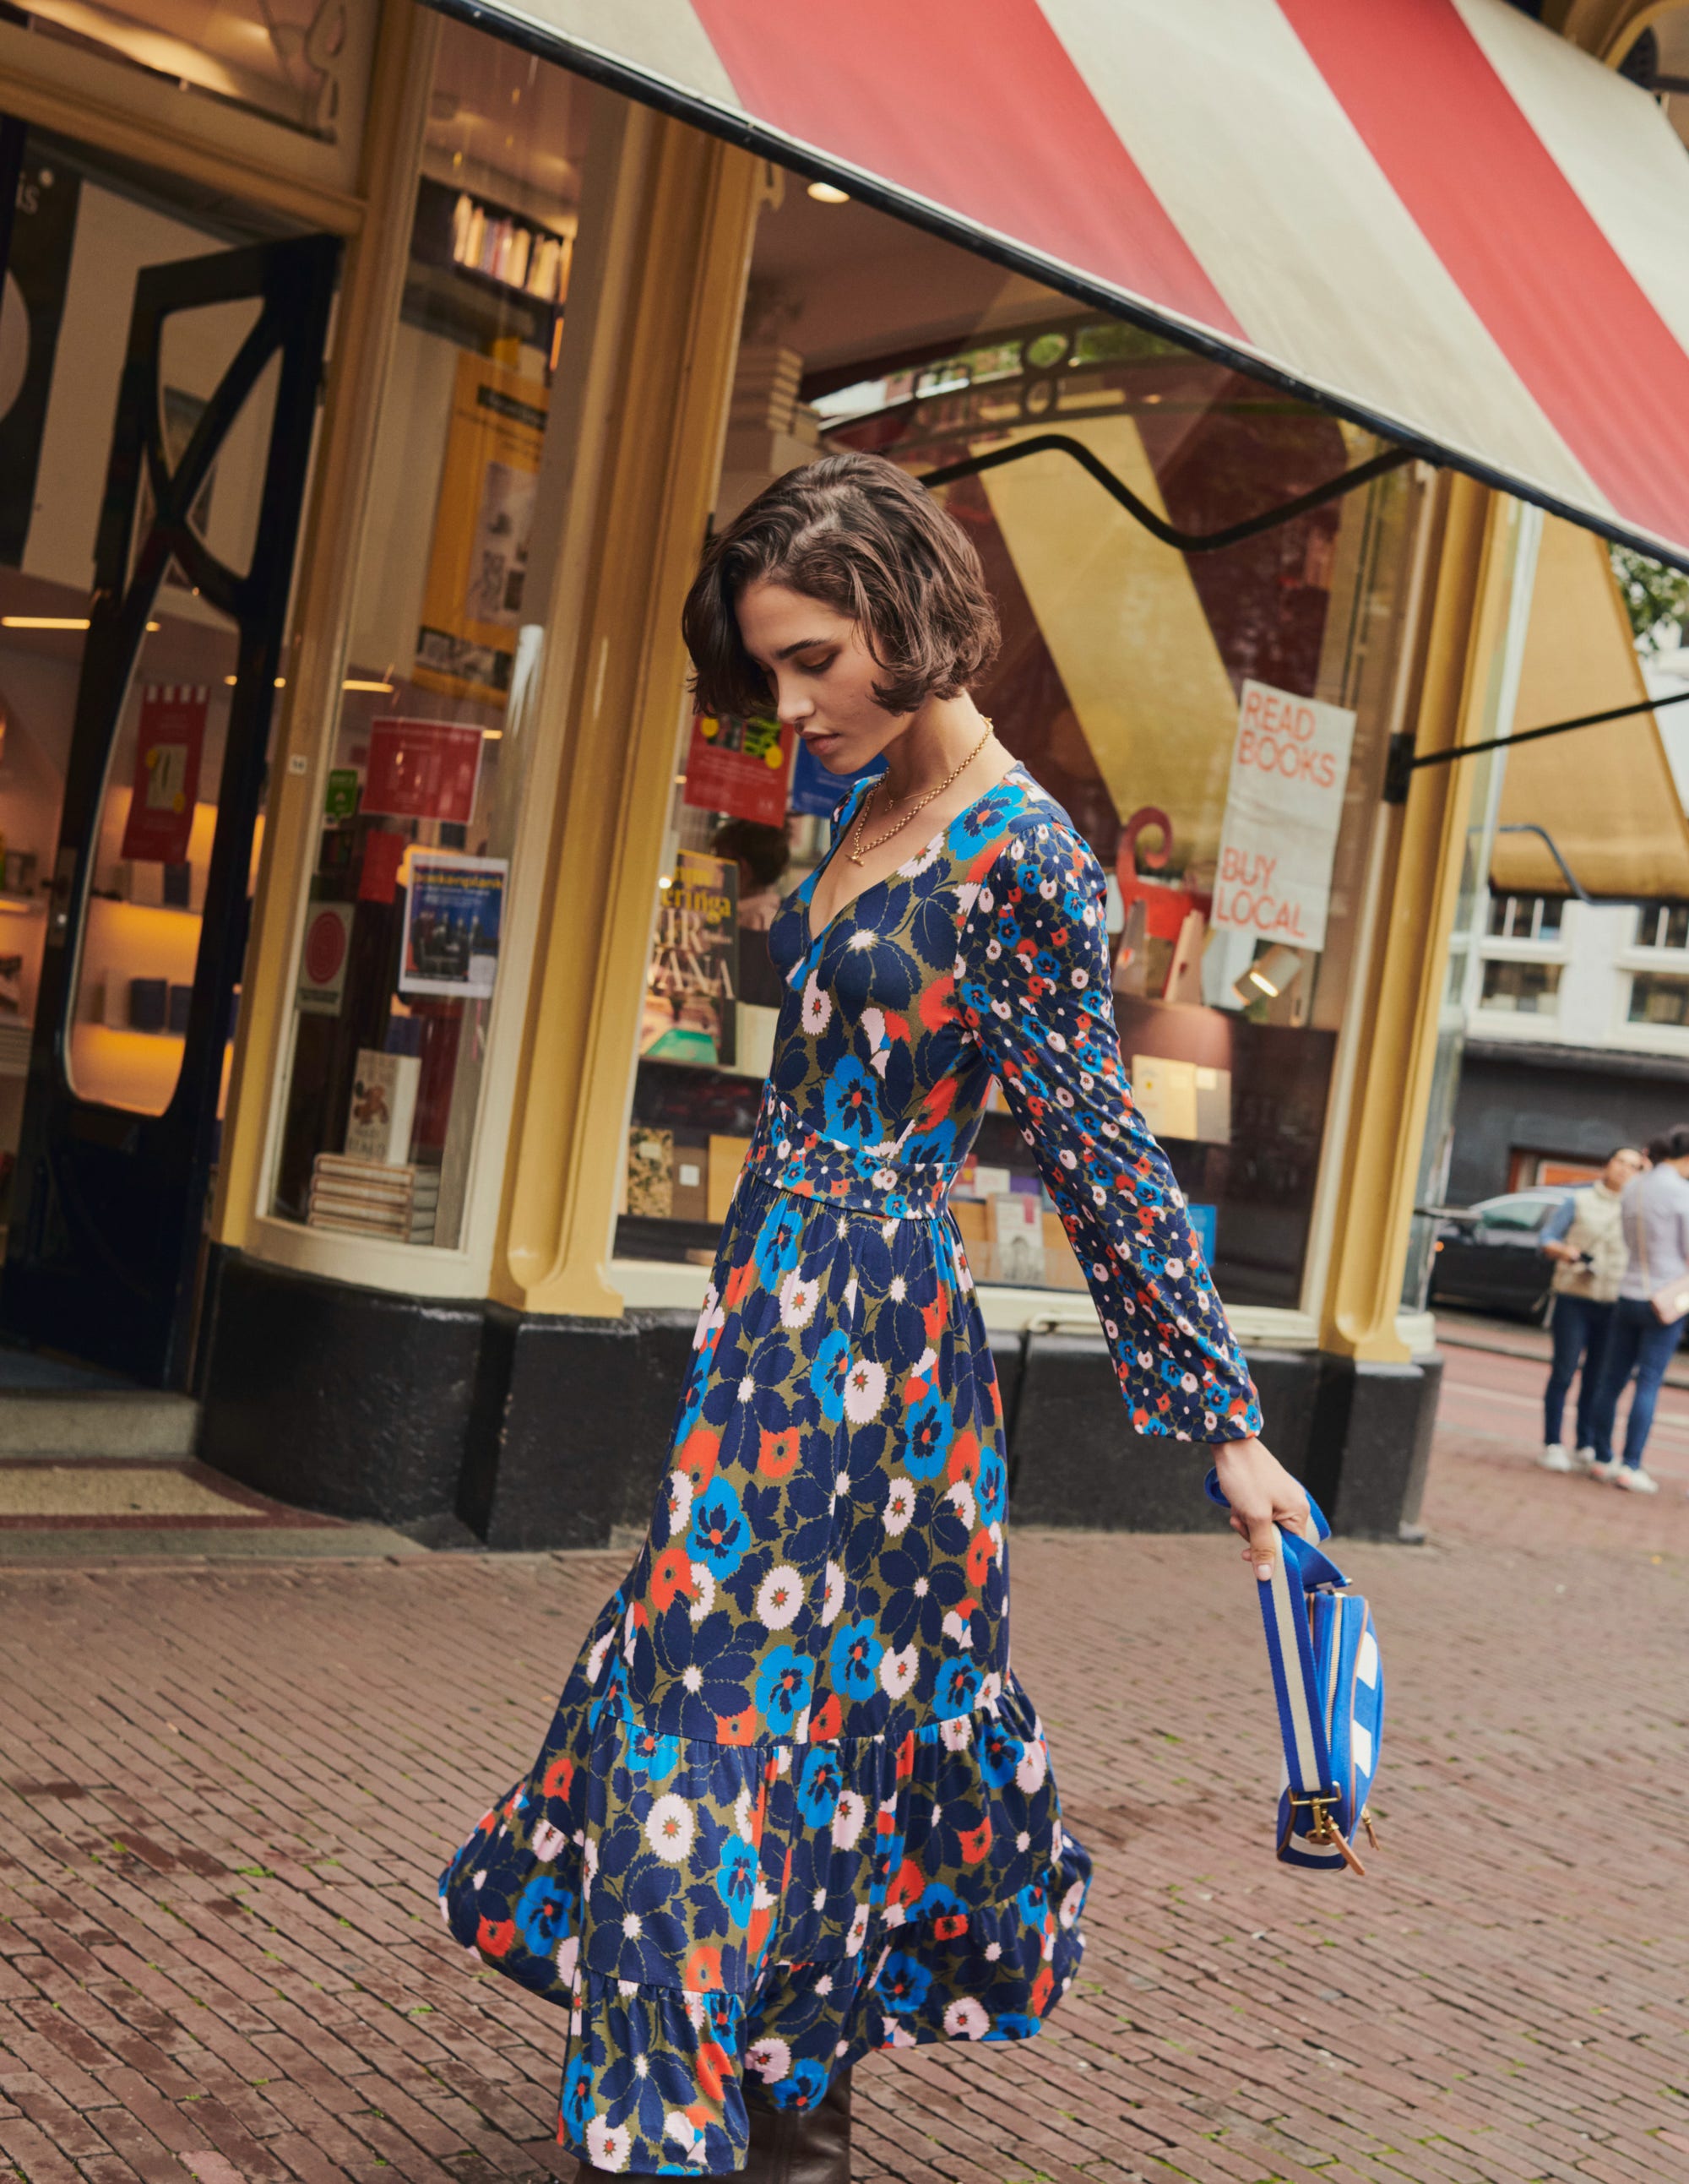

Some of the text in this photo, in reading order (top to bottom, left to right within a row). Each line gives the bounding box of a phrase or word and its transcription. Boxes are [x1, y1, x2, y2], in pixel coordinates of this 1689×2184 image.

[1243, 691, 1316, 742] READ
[1237, 730, 1336, 789] BOOKS
[1220, 846, 1277, 888] BUY
[1216, 889, 1307, 938] LOCAL
